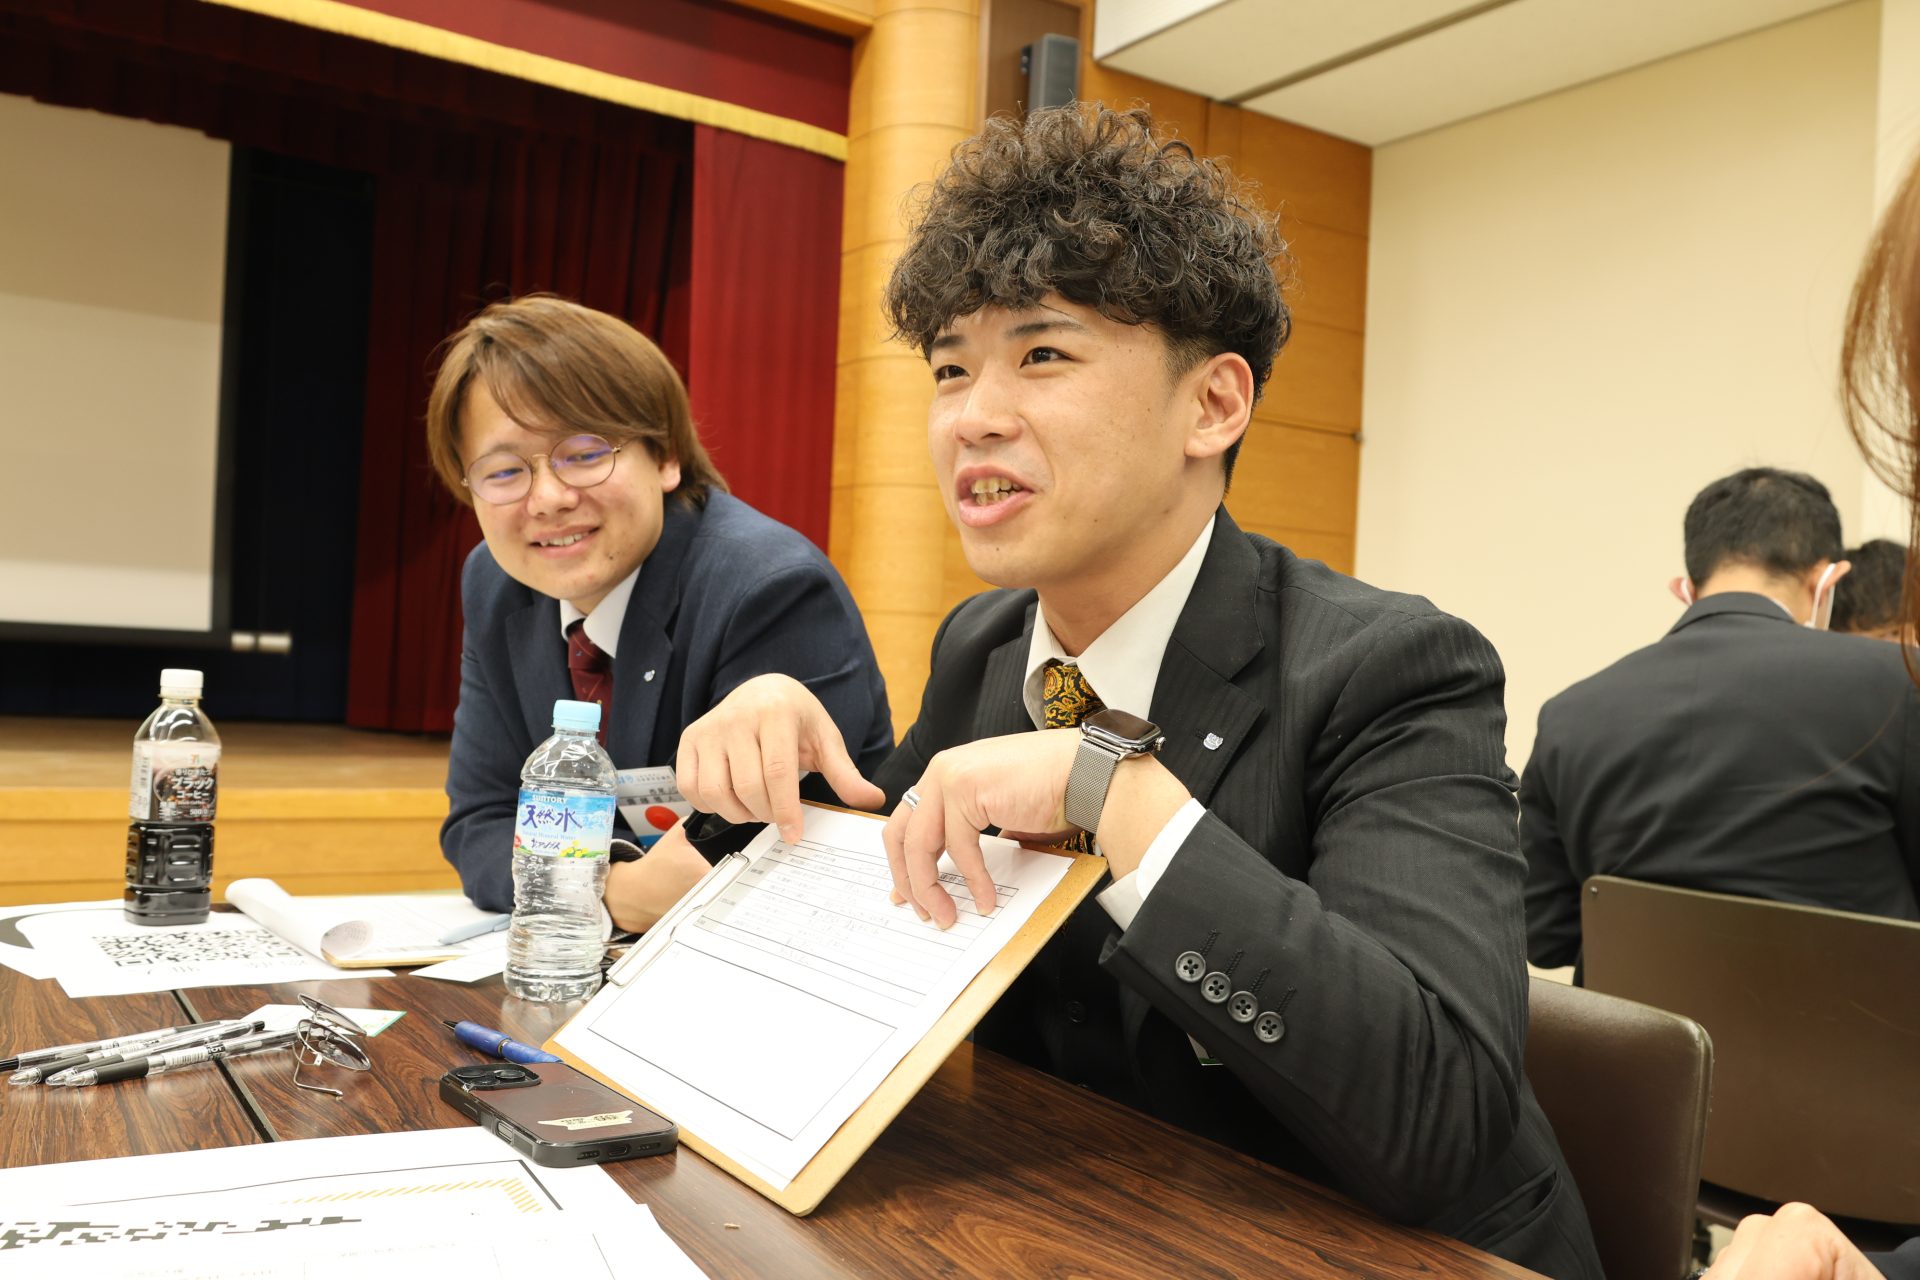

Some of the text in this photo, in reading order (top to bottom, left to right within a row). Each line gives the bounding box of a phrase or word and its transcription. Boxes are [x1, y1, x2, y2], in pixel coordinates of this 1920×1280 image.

[171, 777, 214, 790] ブラック
[176, 790, 210, 799] コーヒー
[532, 794, 568, 804] SUNTORY
[521, 804, 583, 833] 天然水
